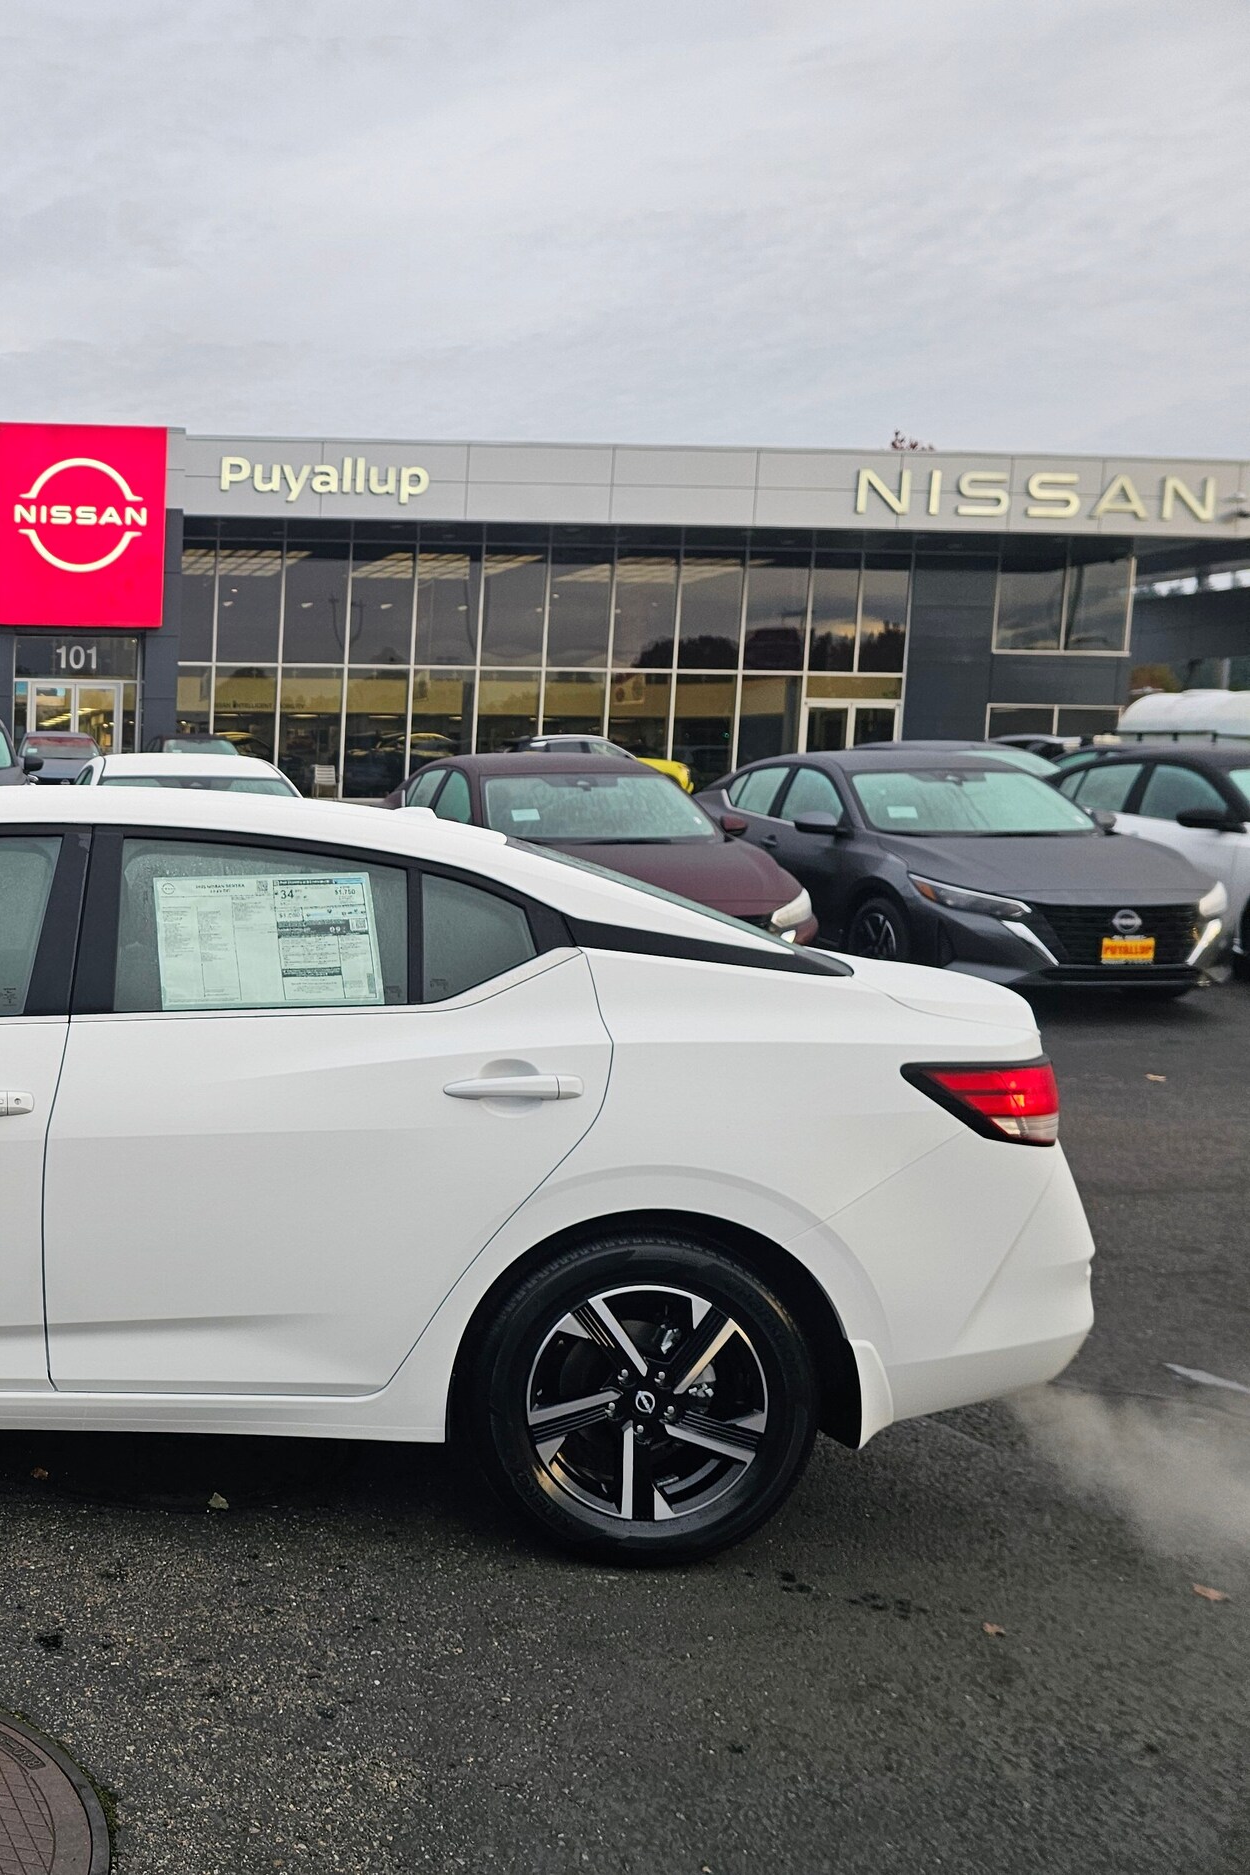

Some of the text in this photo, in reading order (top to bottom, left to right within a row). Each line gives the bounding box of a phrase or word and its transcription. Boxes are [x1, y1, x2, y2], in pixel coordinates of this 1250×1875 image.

[220, 456, 430, 504] Puyallup
[855, 467, 1216, 522] NISSAN
[14, 504, 147, 526] NISSAN
[56, 645, 97, 670] 101
[280, 889, 294, 900] 34
